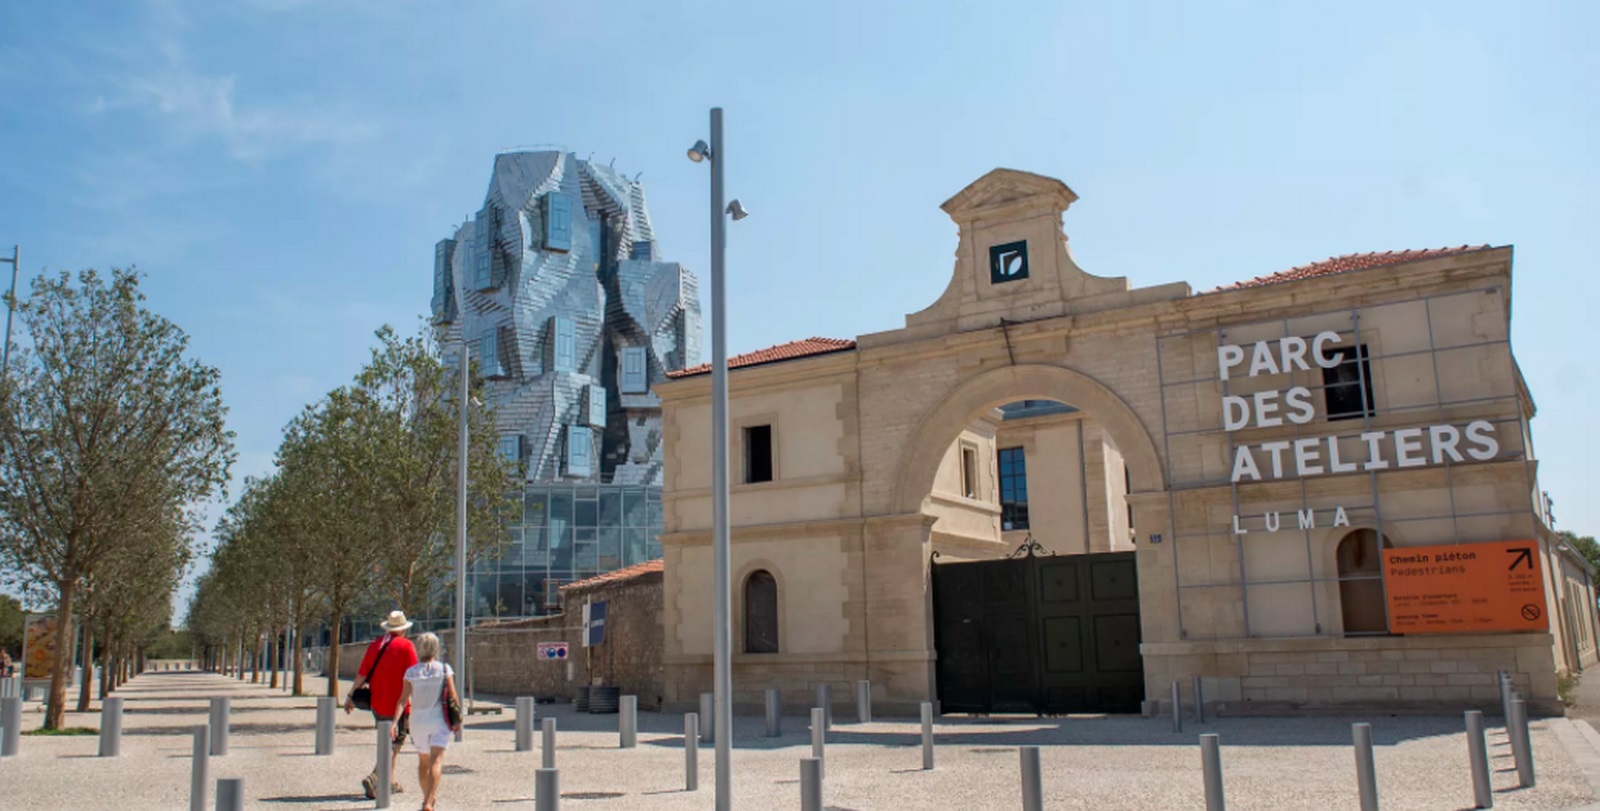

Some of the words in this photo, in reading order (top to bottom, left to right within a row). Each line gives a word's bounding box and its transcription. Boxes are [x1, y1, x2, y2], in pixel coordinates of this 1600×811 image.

[1217, 331, 1344, 381] PARC
[1222, 386, 1315, 431] DES
[1231, 420, 1499, 482] ATELIERS
[1233, 506, 1350, 534] LUMA
[1389, 553, 1429, 565] Chemin
[1435, 551, 1477, 563] piéton
[1391, 565, 1466, 576] Pedestrians
